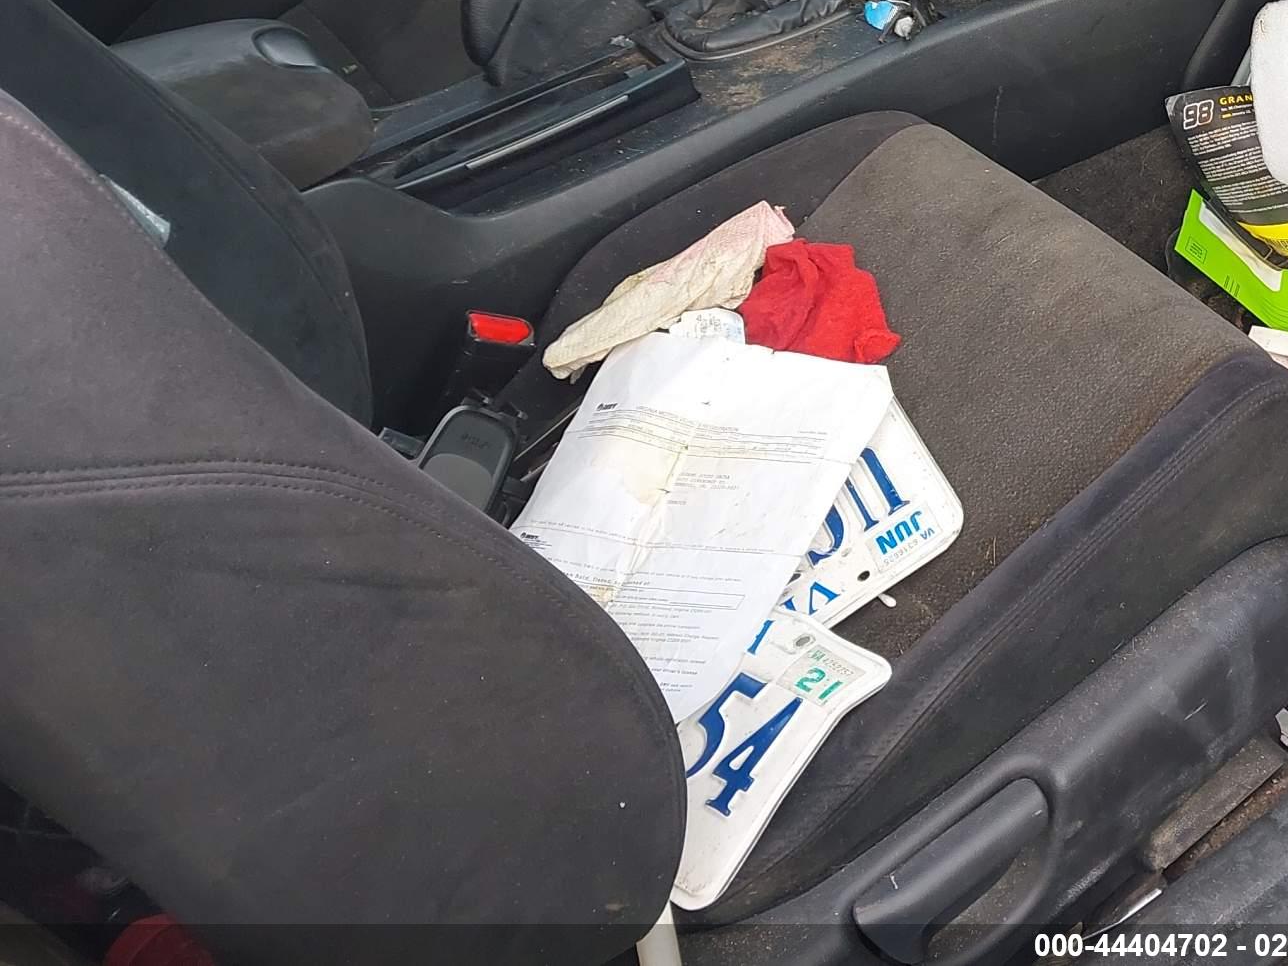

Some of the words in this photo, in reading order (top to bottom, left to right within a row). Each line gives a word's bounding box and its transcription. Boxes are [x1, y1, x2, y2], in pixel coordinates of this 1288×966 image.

[1182, 99, 1215, 131] 98
[875, 511, 922, 555] JUN
[920, 526, 935, 540] VA
[794, 666, 844, 700] 21
